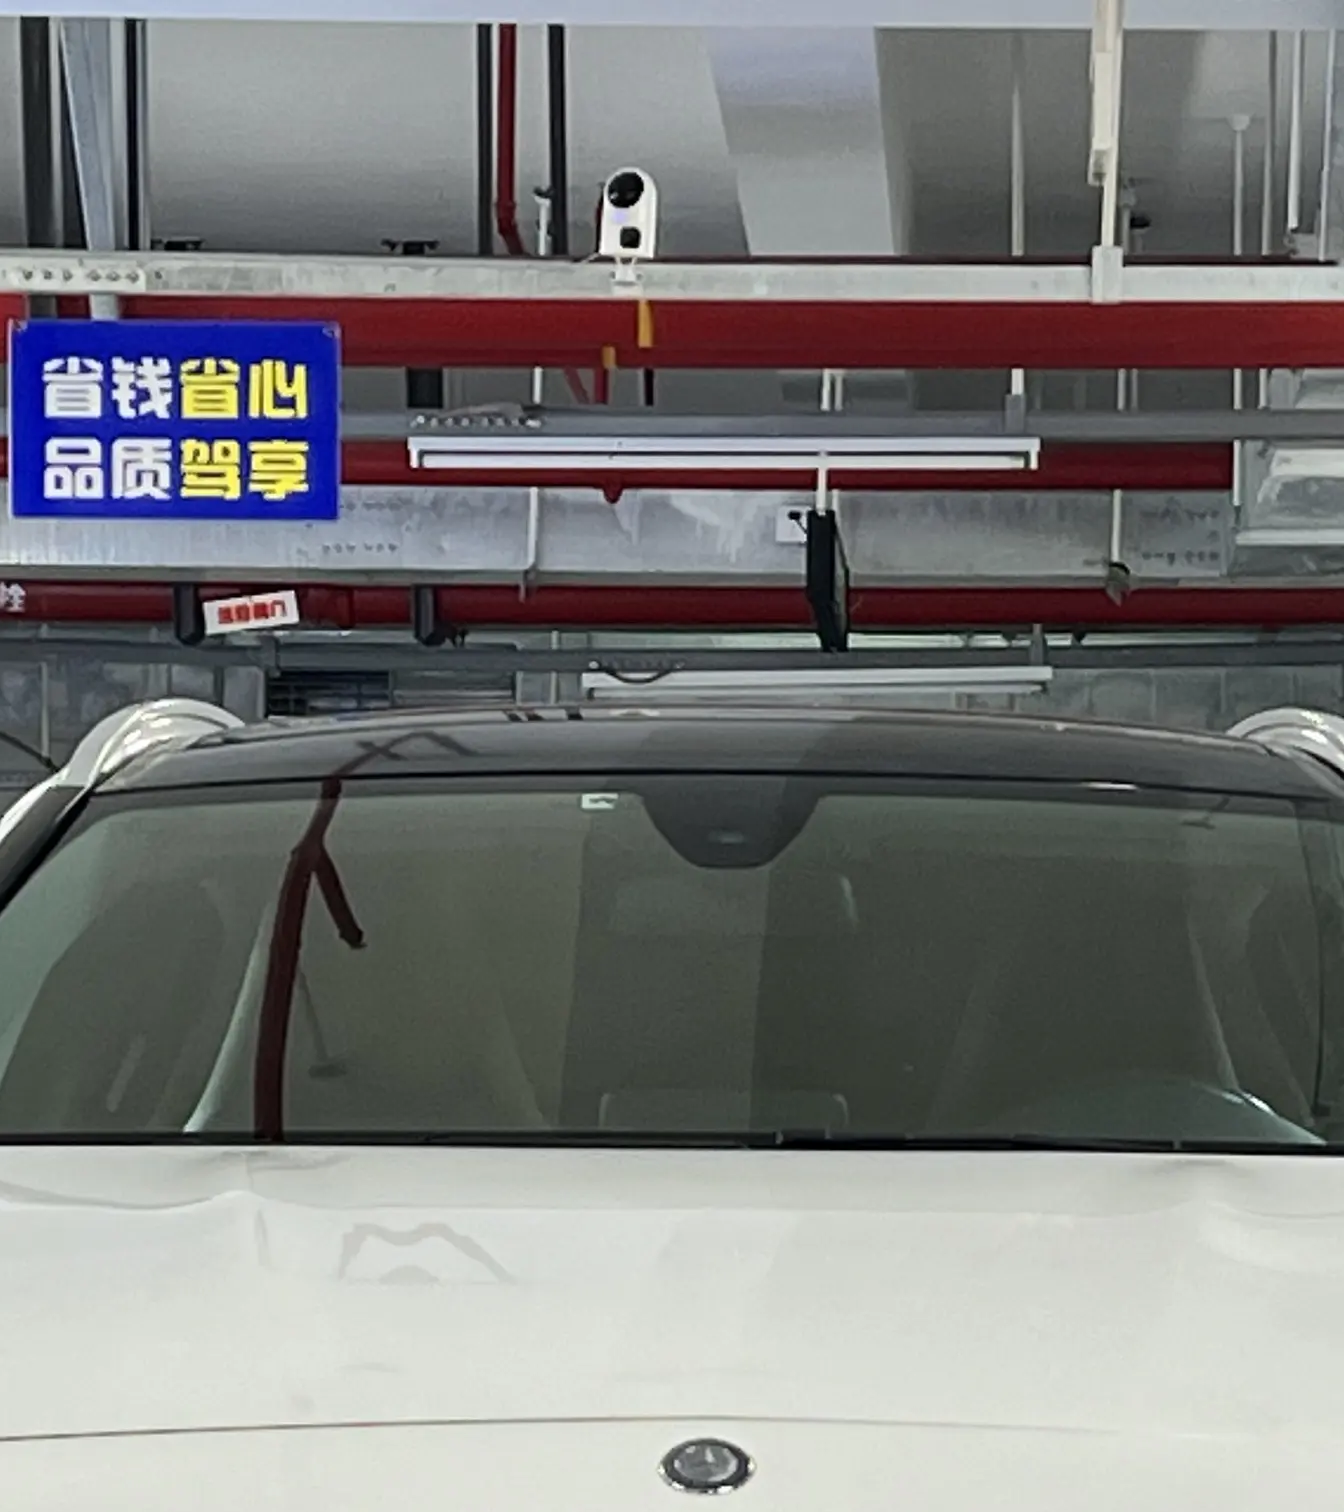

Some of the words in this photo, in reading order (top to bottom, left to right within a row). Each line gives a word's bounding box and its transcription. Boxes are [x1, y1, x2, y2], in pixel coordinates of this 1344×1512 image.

[42, 356, 308, 419] 省钱省心
[43, 436, 309, 500] 品质驾享
